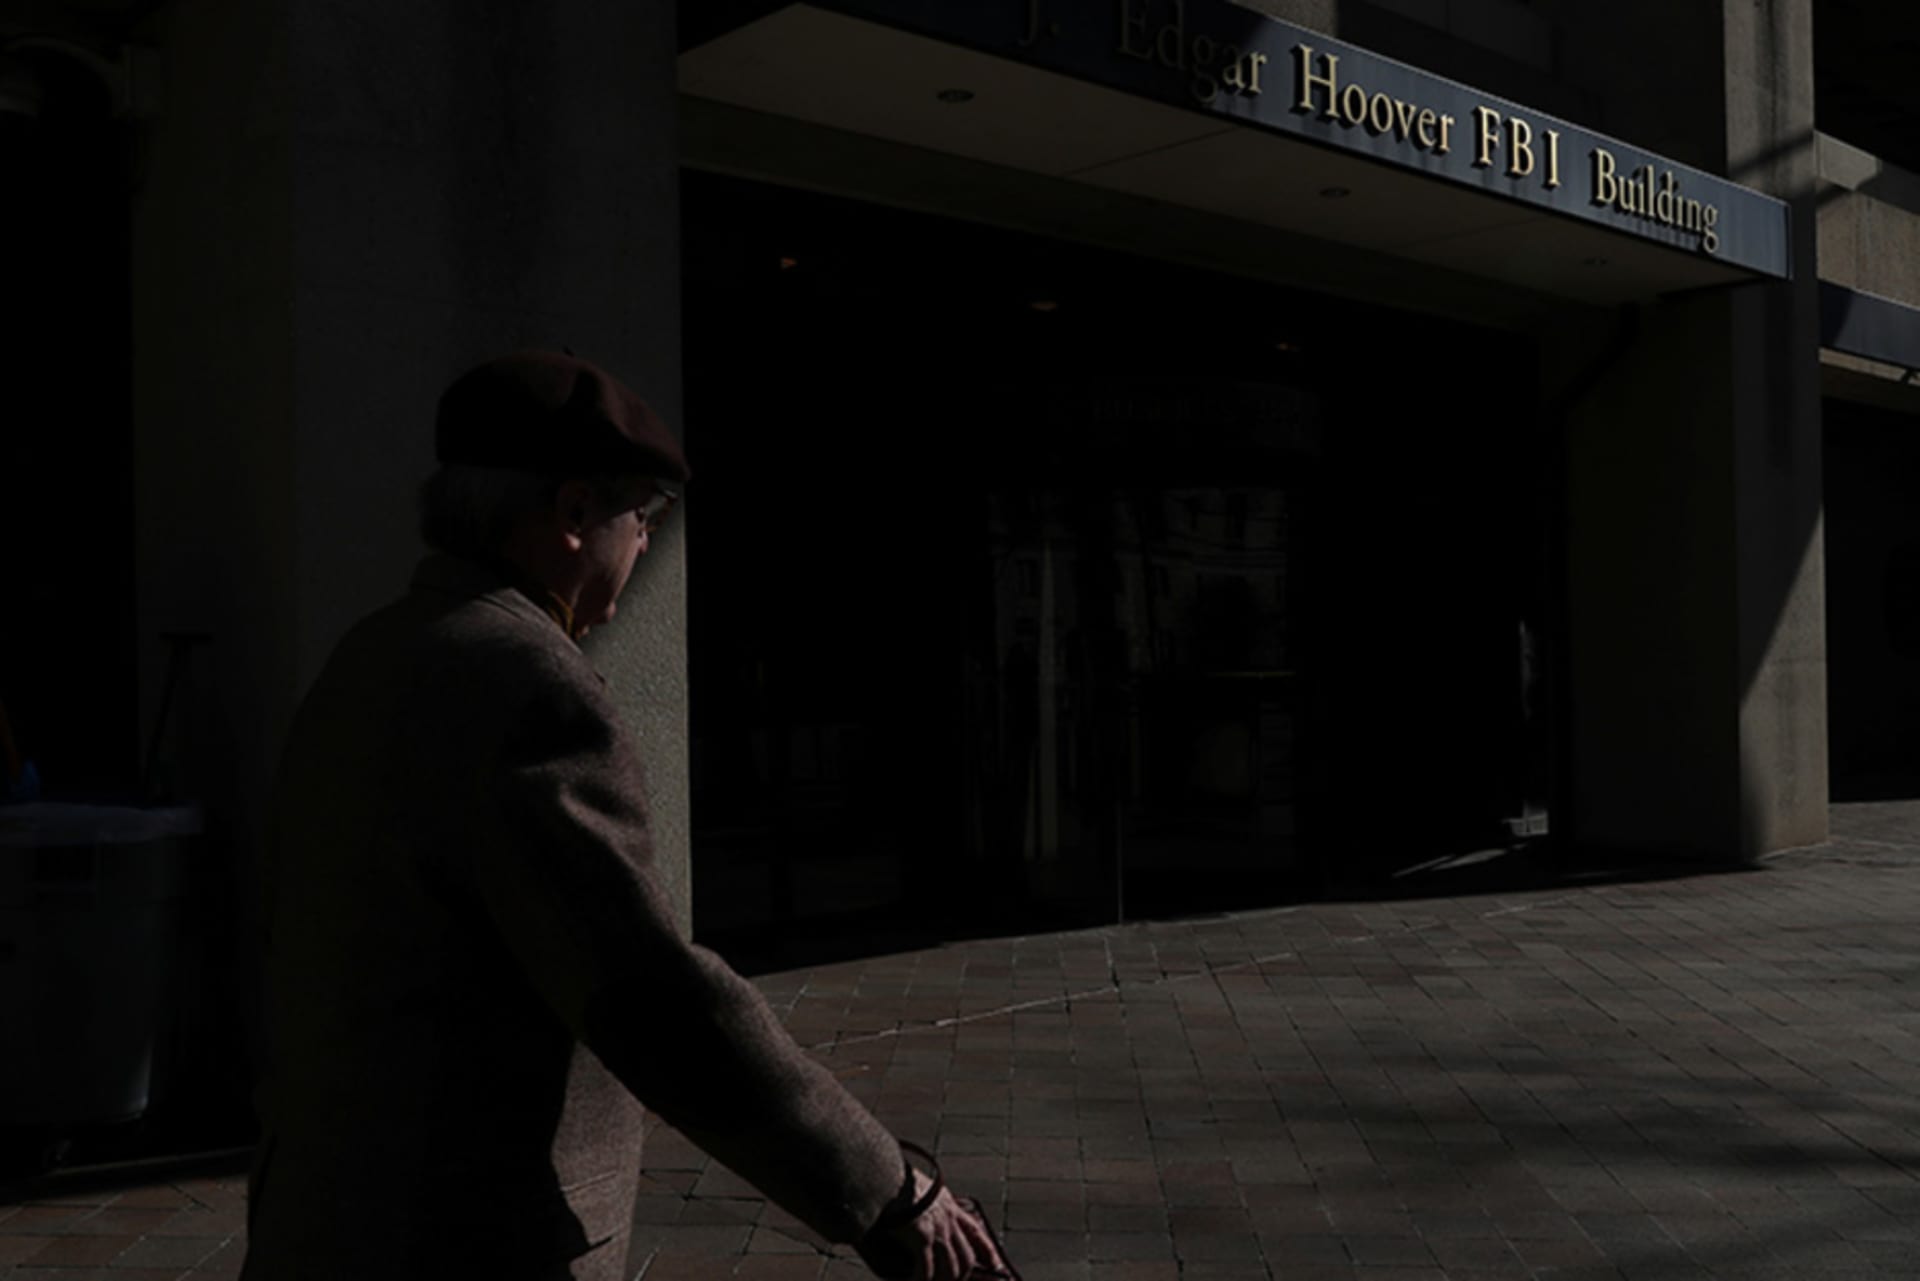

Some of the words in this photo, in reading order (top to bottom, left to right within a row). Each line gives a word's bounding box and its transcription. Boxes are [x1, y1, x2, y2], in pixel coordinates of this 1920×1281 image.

[1114, 0, 1267, 104] Edgar
[1293, 42, 1455, 152] Hoover
[1474, 105, 1561, 188] FBI
[1592, 147, 1720, 253] Building
